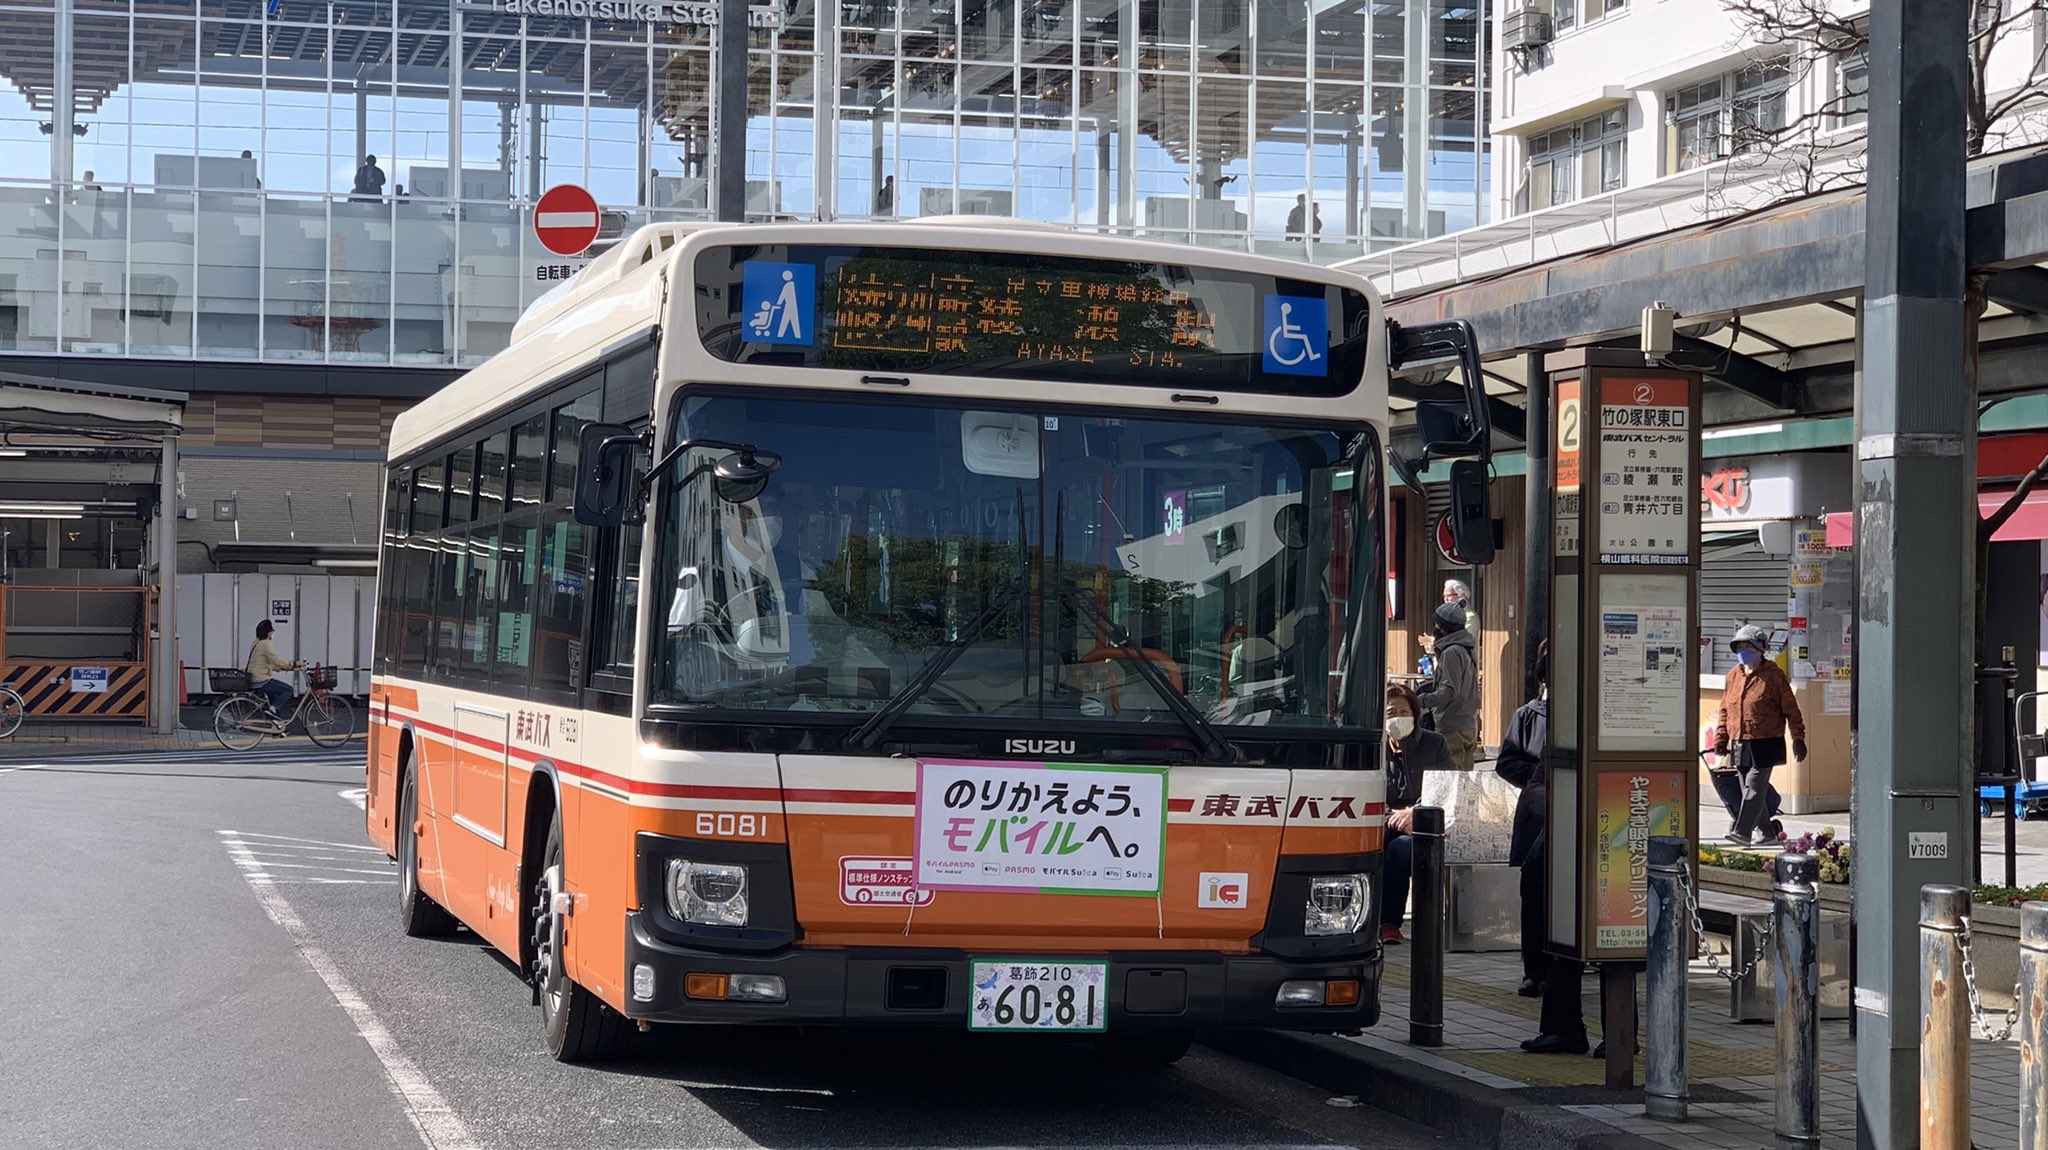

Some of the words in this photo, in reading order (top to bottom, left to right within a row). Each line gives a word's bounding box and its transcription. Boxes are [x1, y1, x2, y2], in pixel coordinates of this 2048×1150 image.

[671, 3, 764, 28] Stan
[536, 265, 588, 280] 自転車
[1562, 404, 1578, 447] 2
[1602, 407, 1685, 428] 竹の塚駅東口
[1602, 434, 1685, 443] 東武バスセントラル
[1623, 503, 1684, 515] 青井六丁目
[516, 708, 551, 748] 東武バス
[1005, 739, 1076, 754] ISUZU
[943, 779, 1141, 818] のりかえよう、
[1200, 794, 1357, 819] 東武バス
[696, 813, 767, 836] 6081
[942, 816, 1140, 858] モバイルへ。
[1911, 844, 1946, 857] V7009
[1004, 866, 1036, 874] PASMO
[1125, 870, 1153, 879] Suica
[994, 984, 1095, 1026] 60-81
